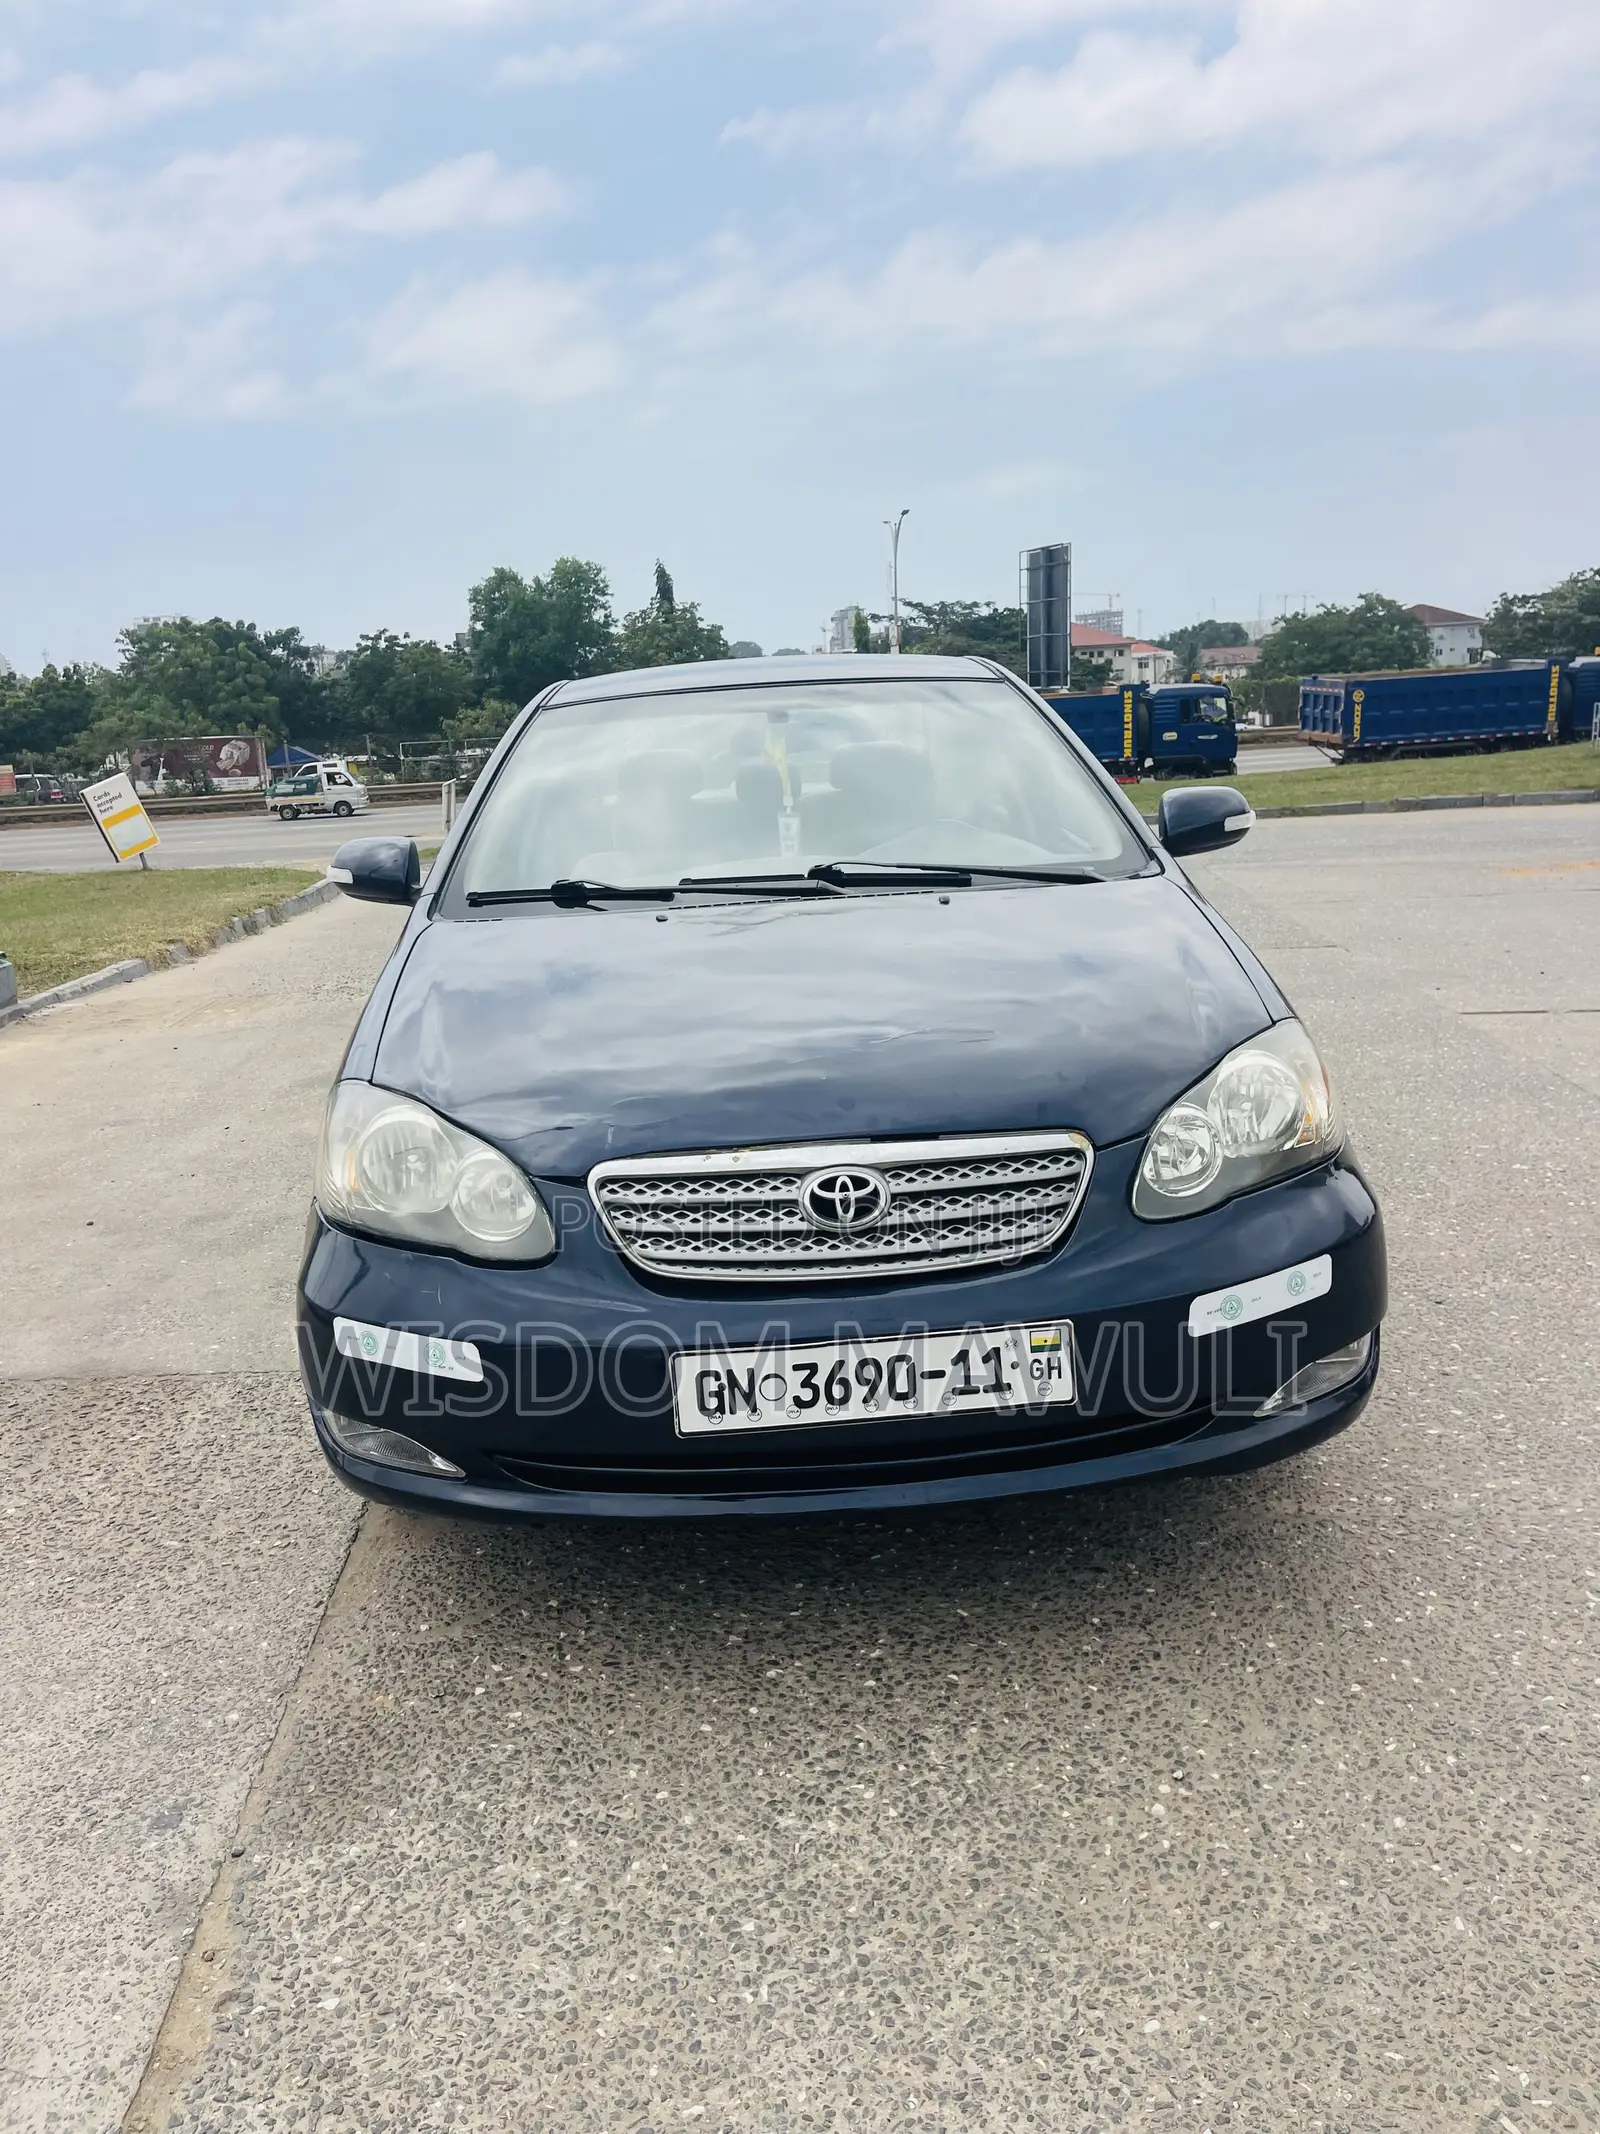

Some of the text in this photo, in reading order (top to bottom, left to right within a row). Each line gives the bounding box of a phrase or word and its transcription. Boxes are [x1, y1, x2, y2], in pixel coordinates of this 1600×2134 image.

[1548, 665, 1559, 721] SINOTRU
[1124, 690, 1132, 759] SINOTRUK
[93, 791, 110, 801] Cards
[97, 792, 122, 809] accepted
[99, 805, 114, 814] here
[695, 1346, 1012, 1416] GN 3690-11
[1029, 1356, 1063, 1381] GH
